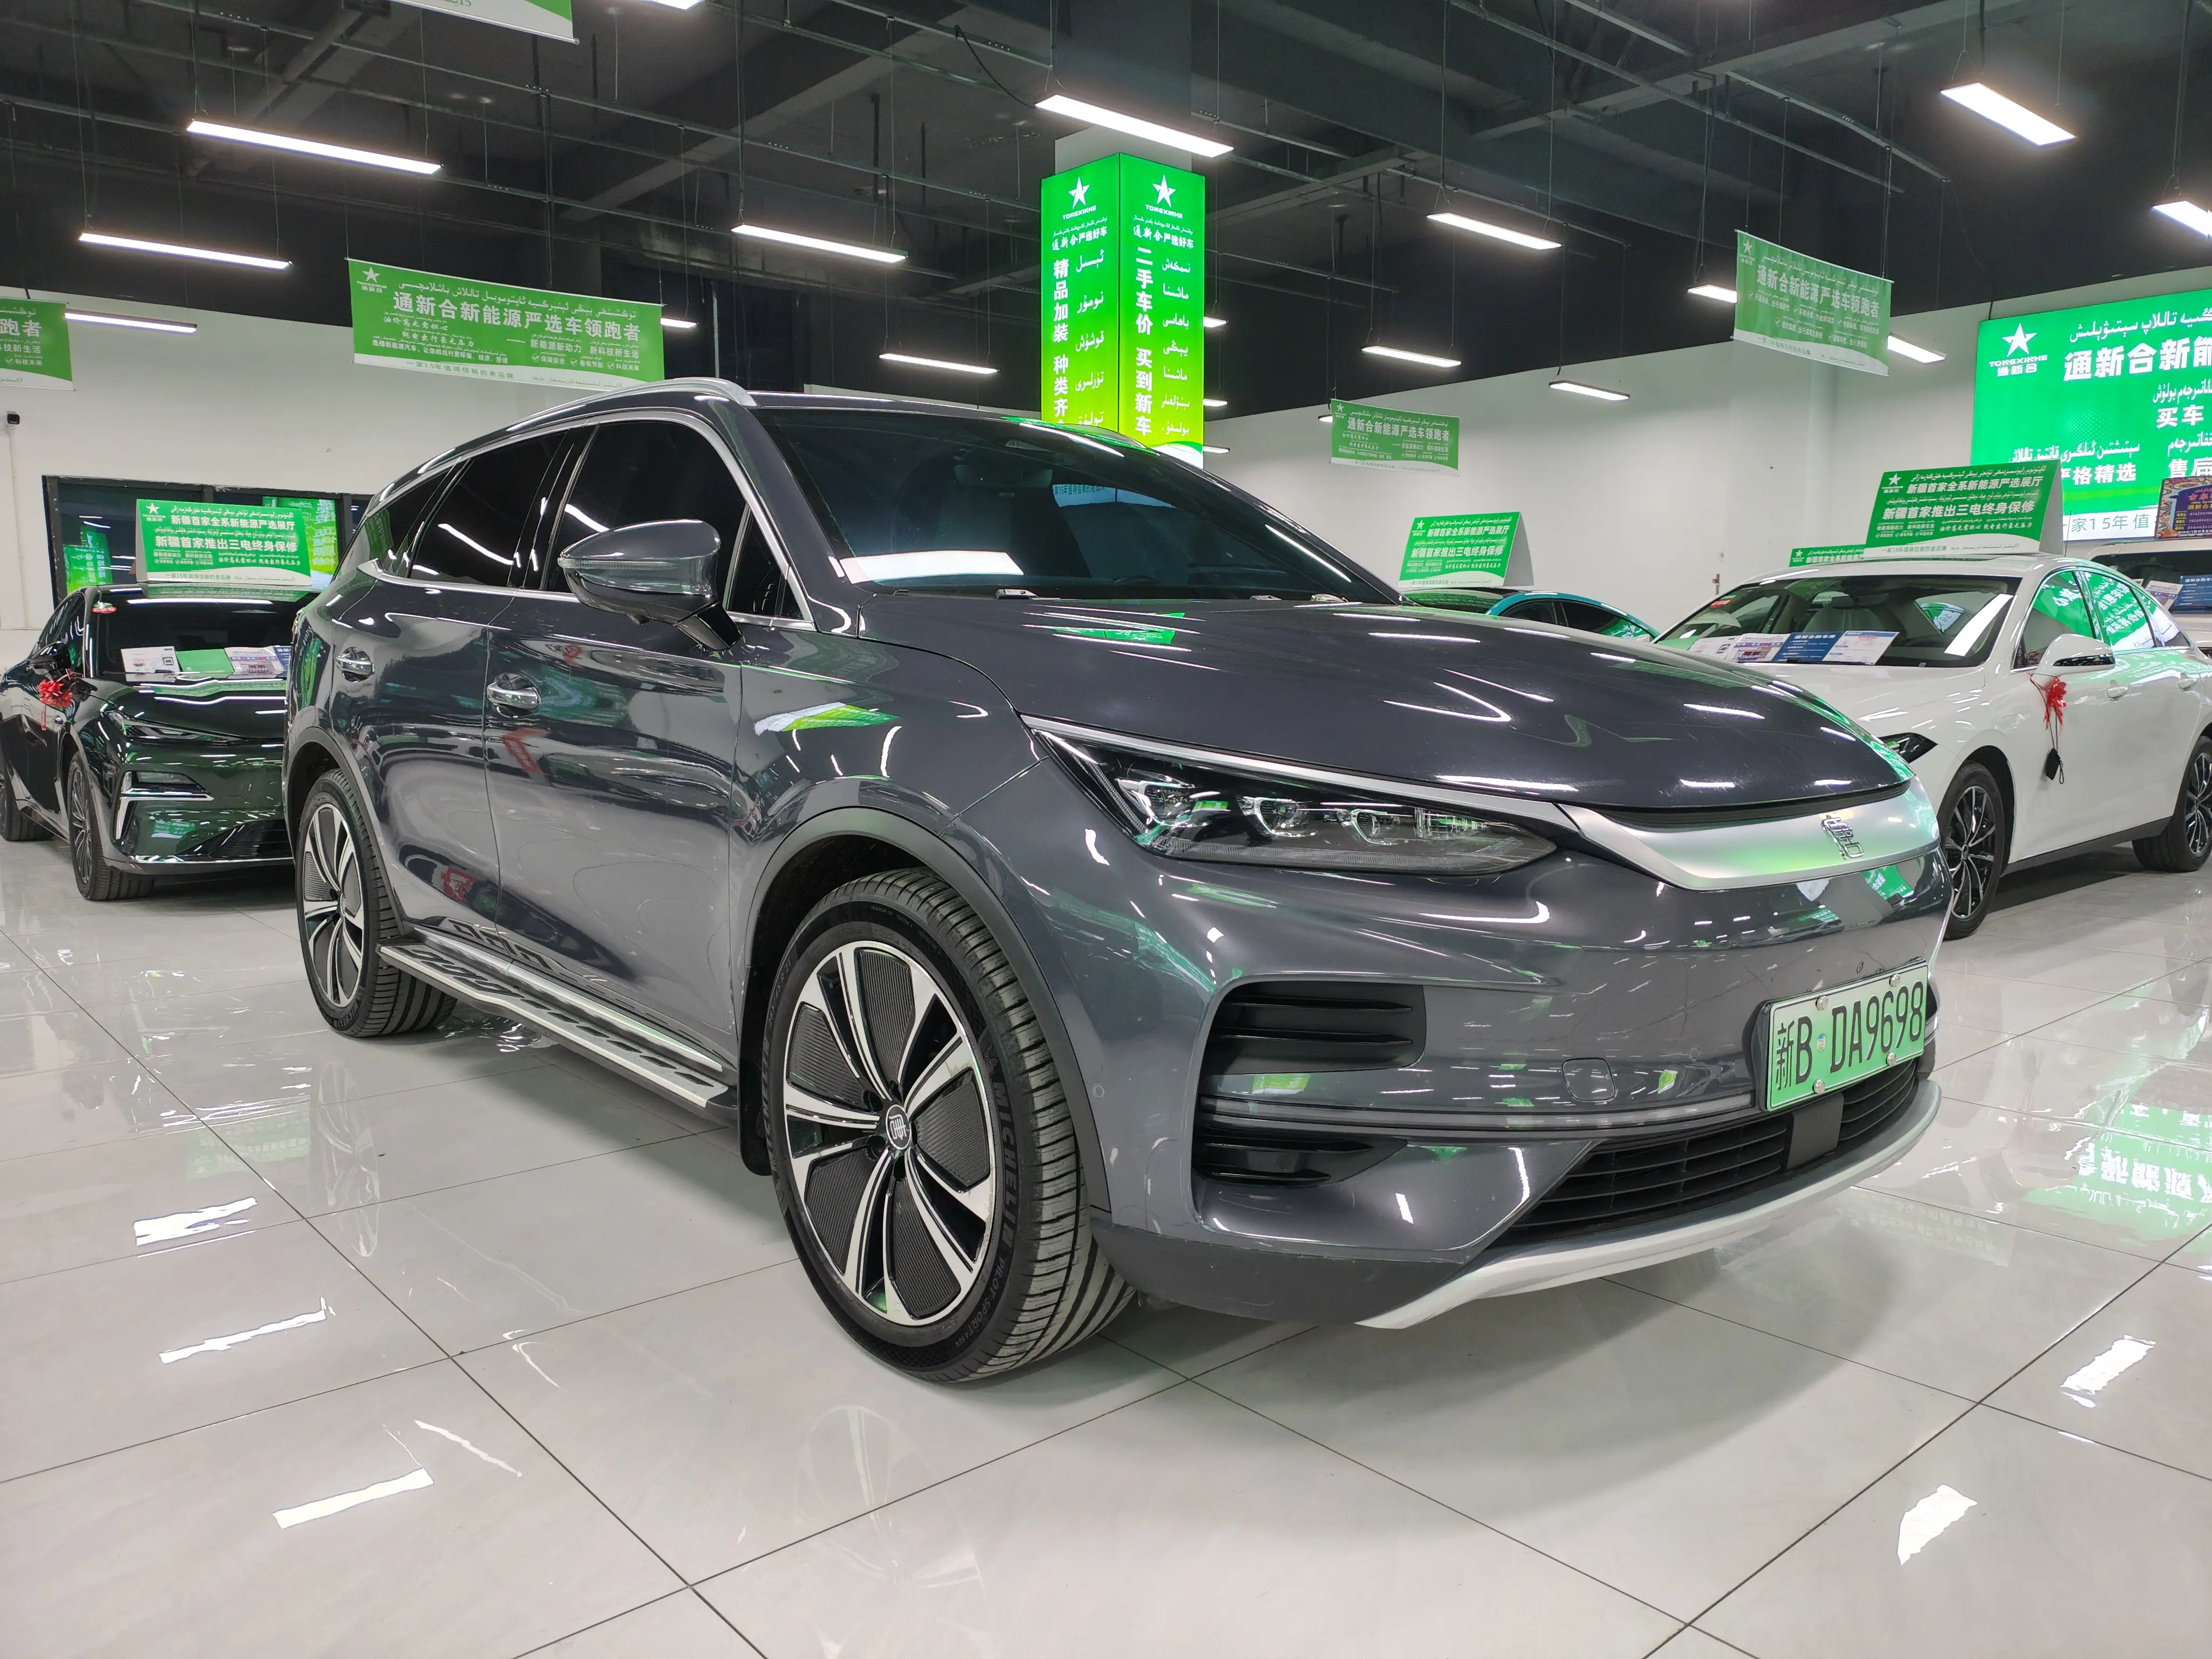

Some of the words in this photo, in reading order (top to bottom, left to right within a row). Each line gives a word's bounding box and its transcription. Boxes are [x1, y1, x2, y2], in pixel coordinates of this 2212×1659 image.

[1062, 205, 1096, 220] TONGXINHE
[1145, 204, 1183, 219] TONGXINHE
[1053, 258, 1069, 343] 精品加装
[1136, 247, 1153, 335] 二手车价
[1757, 264, 1879, 319] 通新合新能源严选车领跑者
[393, 292, 640, 341] 通新合新能源严选车领跑者
[1988, 354, 2048, 367] TONGXINHE
[1997, 363, 2038, 377] 通新合
[1053, 354, 1069, 424] 种类齐
[1135, 347, 1152, 436] 买到新车
[1347, 417, 1450, 441] 通新合新能源严选车领跑者
[2156, 404, 2204, 429] 买车
[1906, 476, 2044, 494] 新疆首家全系新能源严选展厅
[171, 515, 295, 530] 新疆首家全系新能源严选展厅
[1882, 501, 2035, 520] 新疆首家推出三电终身保修
[155, 536, 298, 552] 新疆首家推出三电终身保修
[1410, 545, 1504, 558] 新疆首家推出三电终身保修
[1830, 981, 1924, 1074] DA9698
[993, 1082, 1020, 1249] MICHELIN
[990, 1257, 1006, 1299] PILOT
[967, 1299, 992, 1334] SPORT
